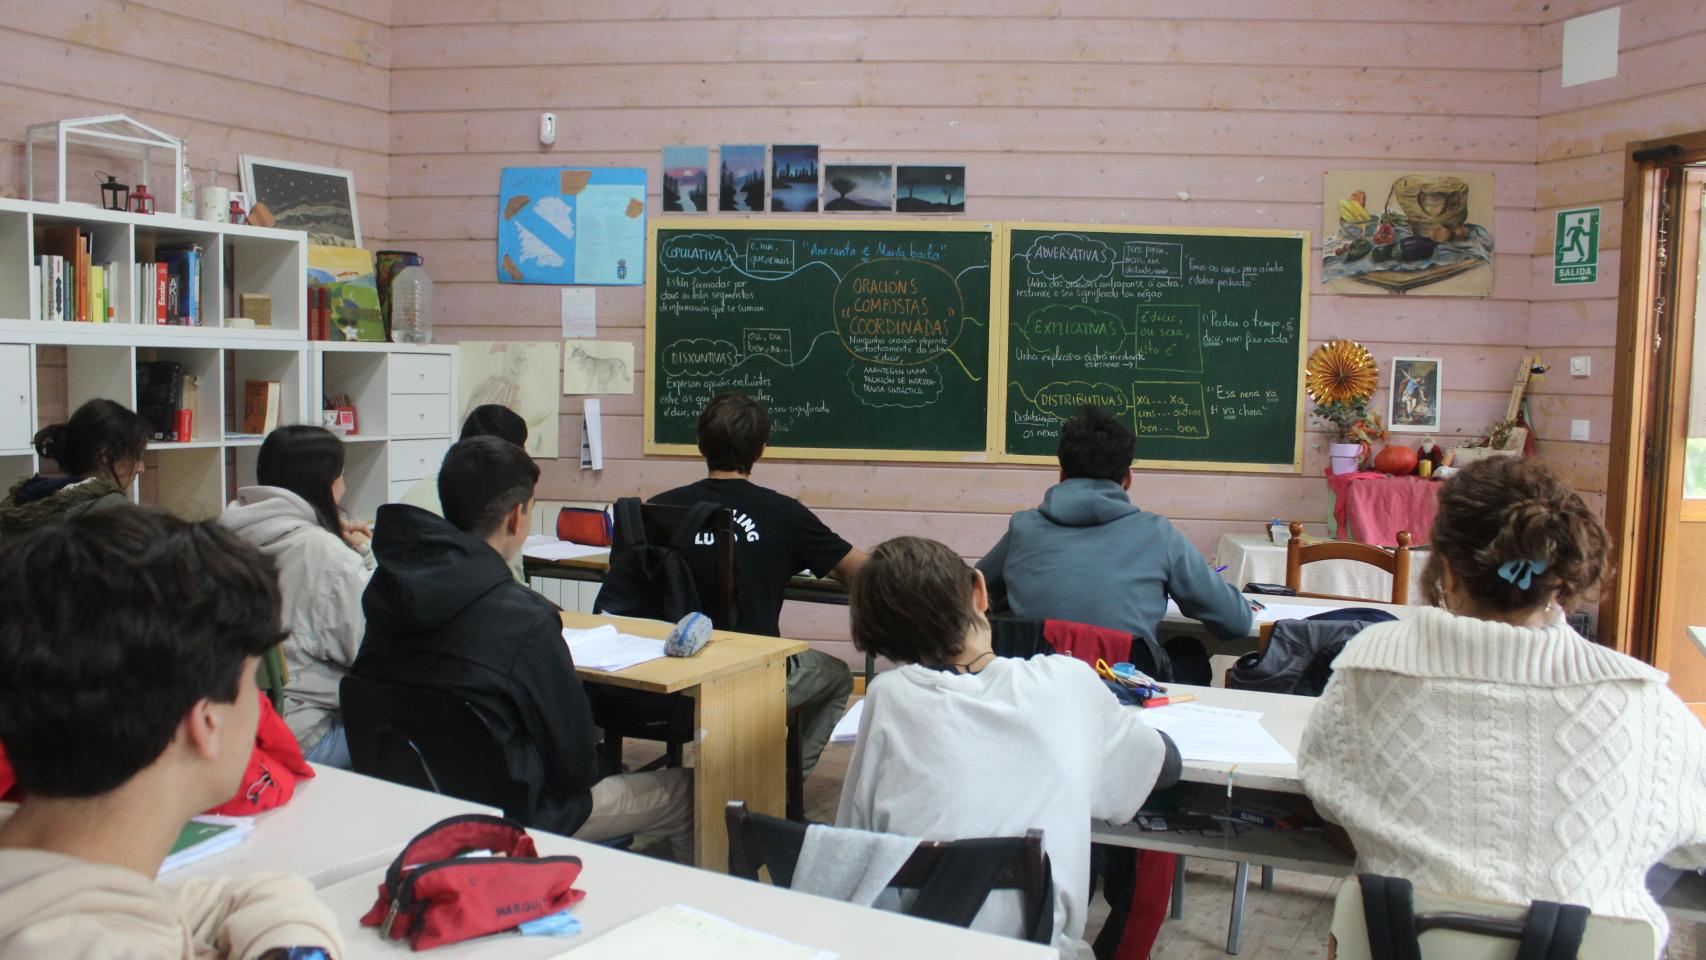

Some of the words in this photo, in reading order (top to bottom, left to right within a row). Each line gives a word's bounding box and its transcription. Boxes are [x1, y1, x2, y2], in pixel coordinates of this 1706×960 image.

[666, 247, 729, 262] COPULATIVAS
[828, 241, 855, 257] canta
[876, 242, 903, 259] María
[1034, 245, 1107, 263] ADVERSATIVAS
[1558, 267, 1592, 277] SALIDA
[666, 276, 688, 287] Están
[692, 276, 730, 294] formadas
[734, 281, 746, 293] por
[1027, 277, 1047, 288] Unha
[1049, 273, 1063, 288] das
[1188, 274, 1214, 286] estaba
[660, 290, 679, 300] dous
[711, 288, 754, 307] segmentos
[1017, 289, 1050, 298] restrinxe
[1062, 289, 1075, 297] seu
[1077, 288, 1119, 303] significado
[659, 302, 669, 311] de
[669, 301, 709, 316] información
[711, 305, 725, 319] que
[854, 298, 928, 316] COMPOSTAS
[1034, 320, 1117, 336] EXPLICATIVAS
[1242, 320, 1249, 328] o
[1140, 328, 1154, 337] ou
[849, 335, 884, 346] Ningunha
[888, 336, 916, 344] oración
[917, 337, 947, 347] depende
[917, 343, 926, 353] da
[1245, 331, 1262, 352] fixo
[671, 352, 732, 366] DISXUNTIVAS
[1016, 346, 1038, 360] Unha
[666, 377, 701, 395] Expresan
[732, 372, 771, 388] excluíntes
[659, 392, 679, 405] entre
[681, 395, 692, 403] os
[695, 396, 710, 409] que
[1041, 393, 1124, 406] DISTRIBUTIVAS
[1240, 389, 1260, 398] nena
[1265, 390, 1278, 398] xa
[788, 400, 829, 417] significado
[1222, 407, 1235, 415] xa
[1023, 430, 1034, 439] os
[1036, 429, 1059, 437] nexos
